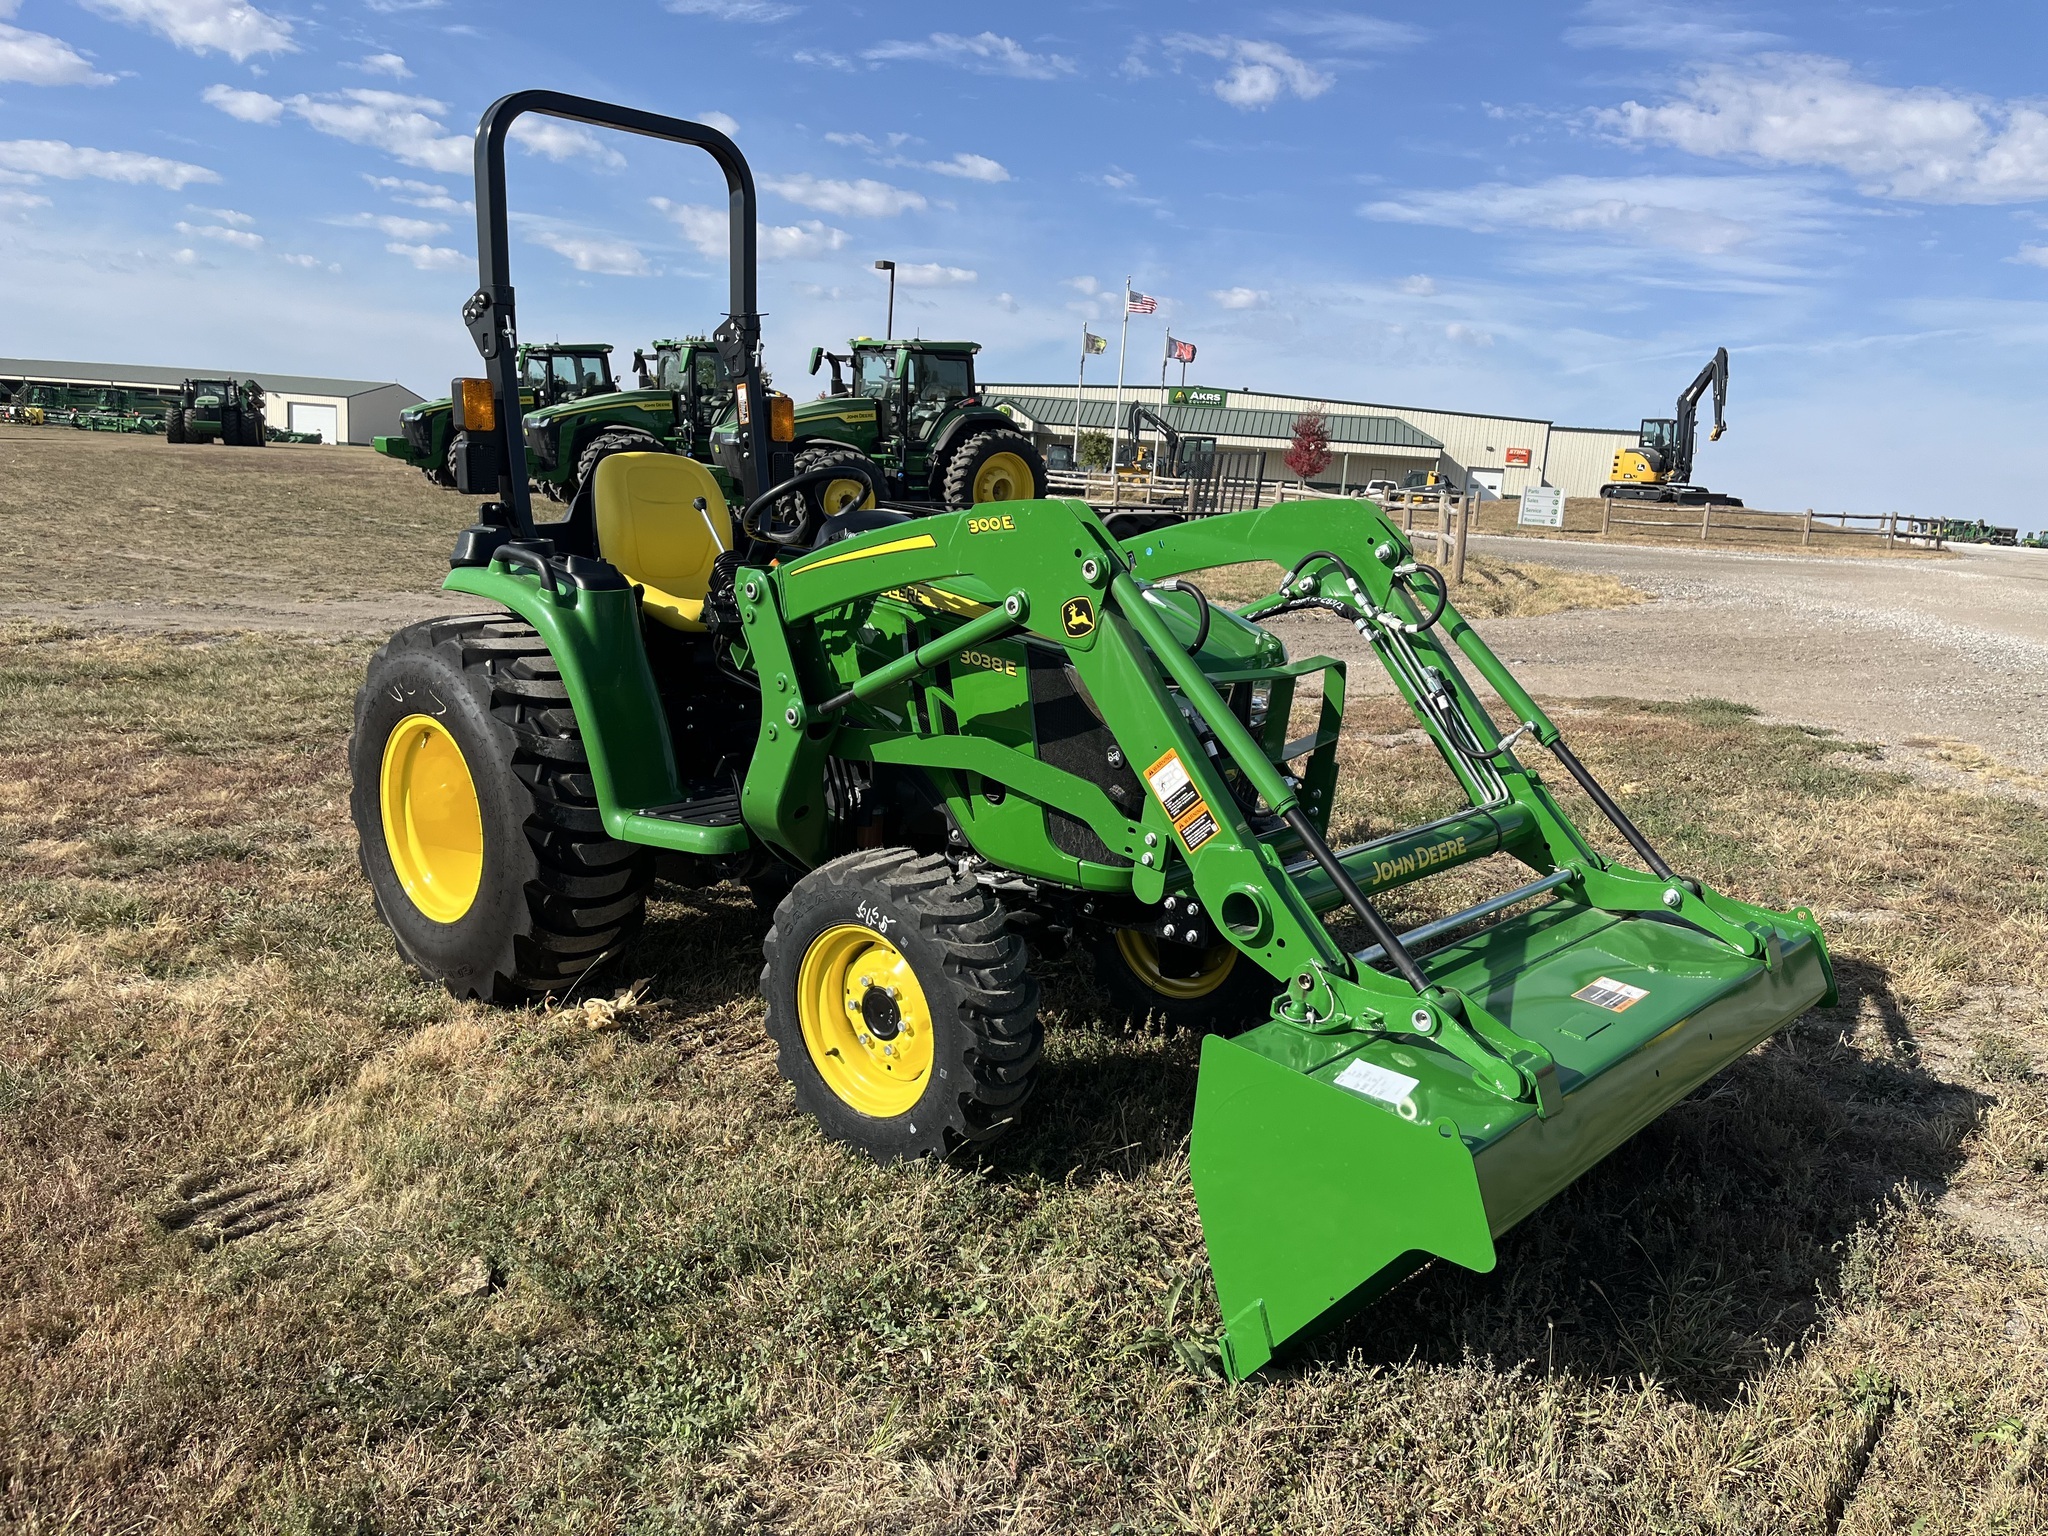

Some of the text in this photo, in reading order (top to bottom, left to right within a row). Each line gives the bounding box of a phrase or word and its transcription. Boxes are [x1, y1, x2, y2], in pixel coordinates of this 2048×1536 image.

[1190, 391, 1221, 401] AKRS
[1153, 753, 1173, 772] WARNING
[1184, 806, 1205, 825] WARNING
[1372, 836, 1467, 885] JOHN DEERE
[784, 889, 858, 936] GALAXY
